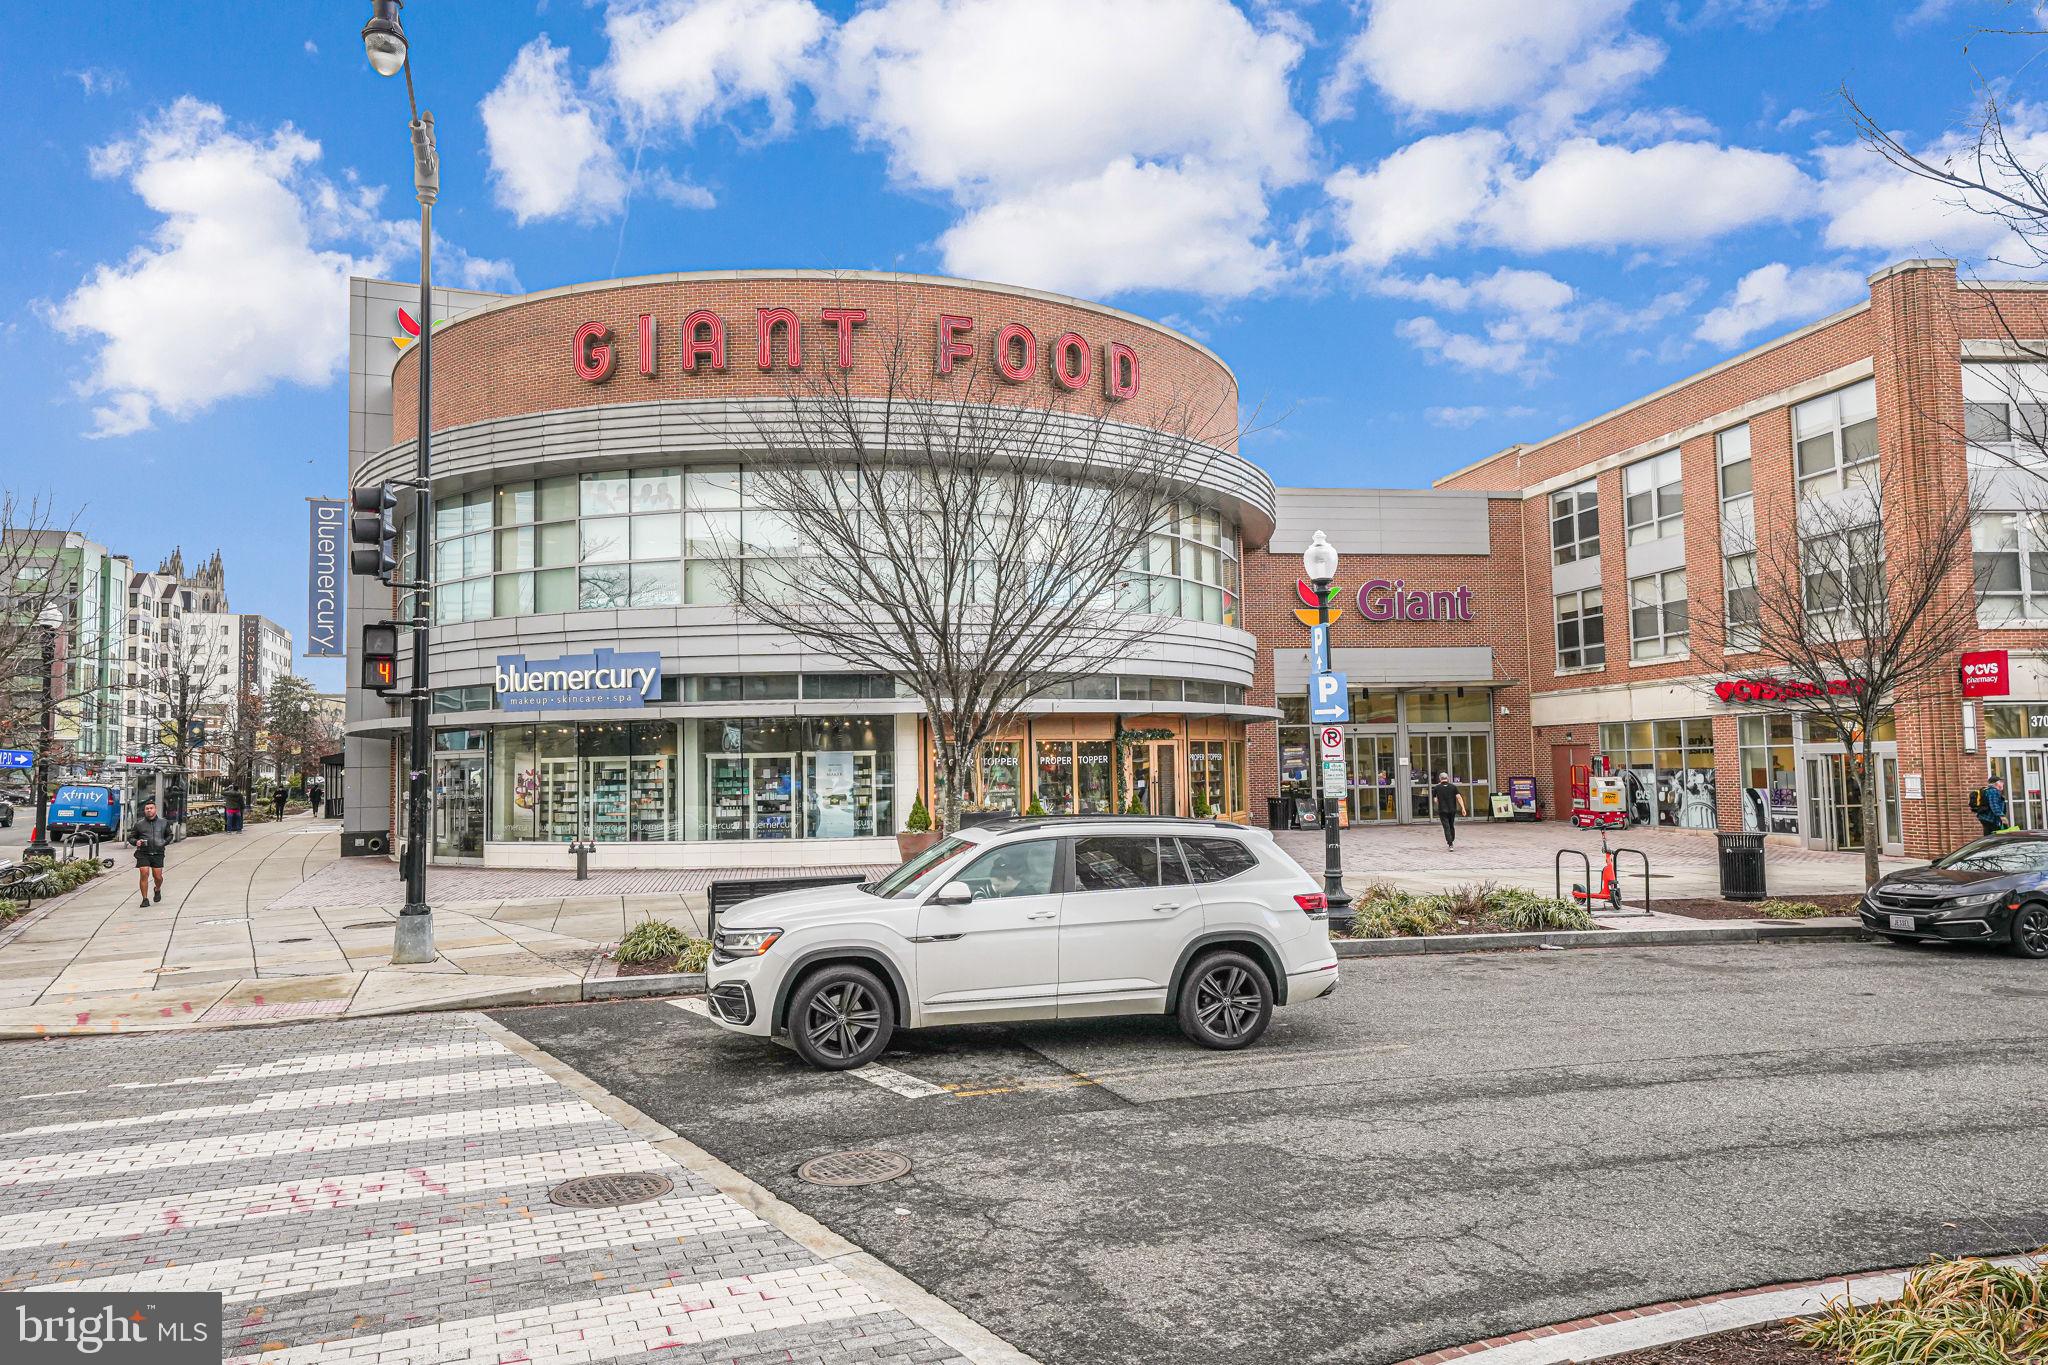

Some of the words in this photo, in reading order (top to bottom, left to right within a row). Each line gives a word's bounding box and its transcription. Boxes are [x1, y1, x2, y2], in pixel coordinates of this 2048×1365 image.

[572, 306, 868, 384] GIANT
[935, 313, 1141, 400] FOOD
[311, 506, 343, 649] bluemercury
[1356, 578, 1476, 621] Giant
[1314, 627, 1323, 655] P
[379, 662, 391, 684] 4
[1974, 663, 1999, 675] CVS
[496, 664, 657, 696] bluemercury
[1966, 675, 1998, 685] pharmacy
[1318, 676, 1339, 703] P
[510, 696, 548, 706] makeup
[557, 694, 603, 704] skincare
[612, 694, 632, 704] spa
[981, 757, 1019, 767] TOPPER
[1040, 756, 1072, 766] PROPER
[1078, 755, 1109, 765] TOPPER
[62, 789, 104, 803] xfinity
[1635, 790, 1651, 800] CVS
